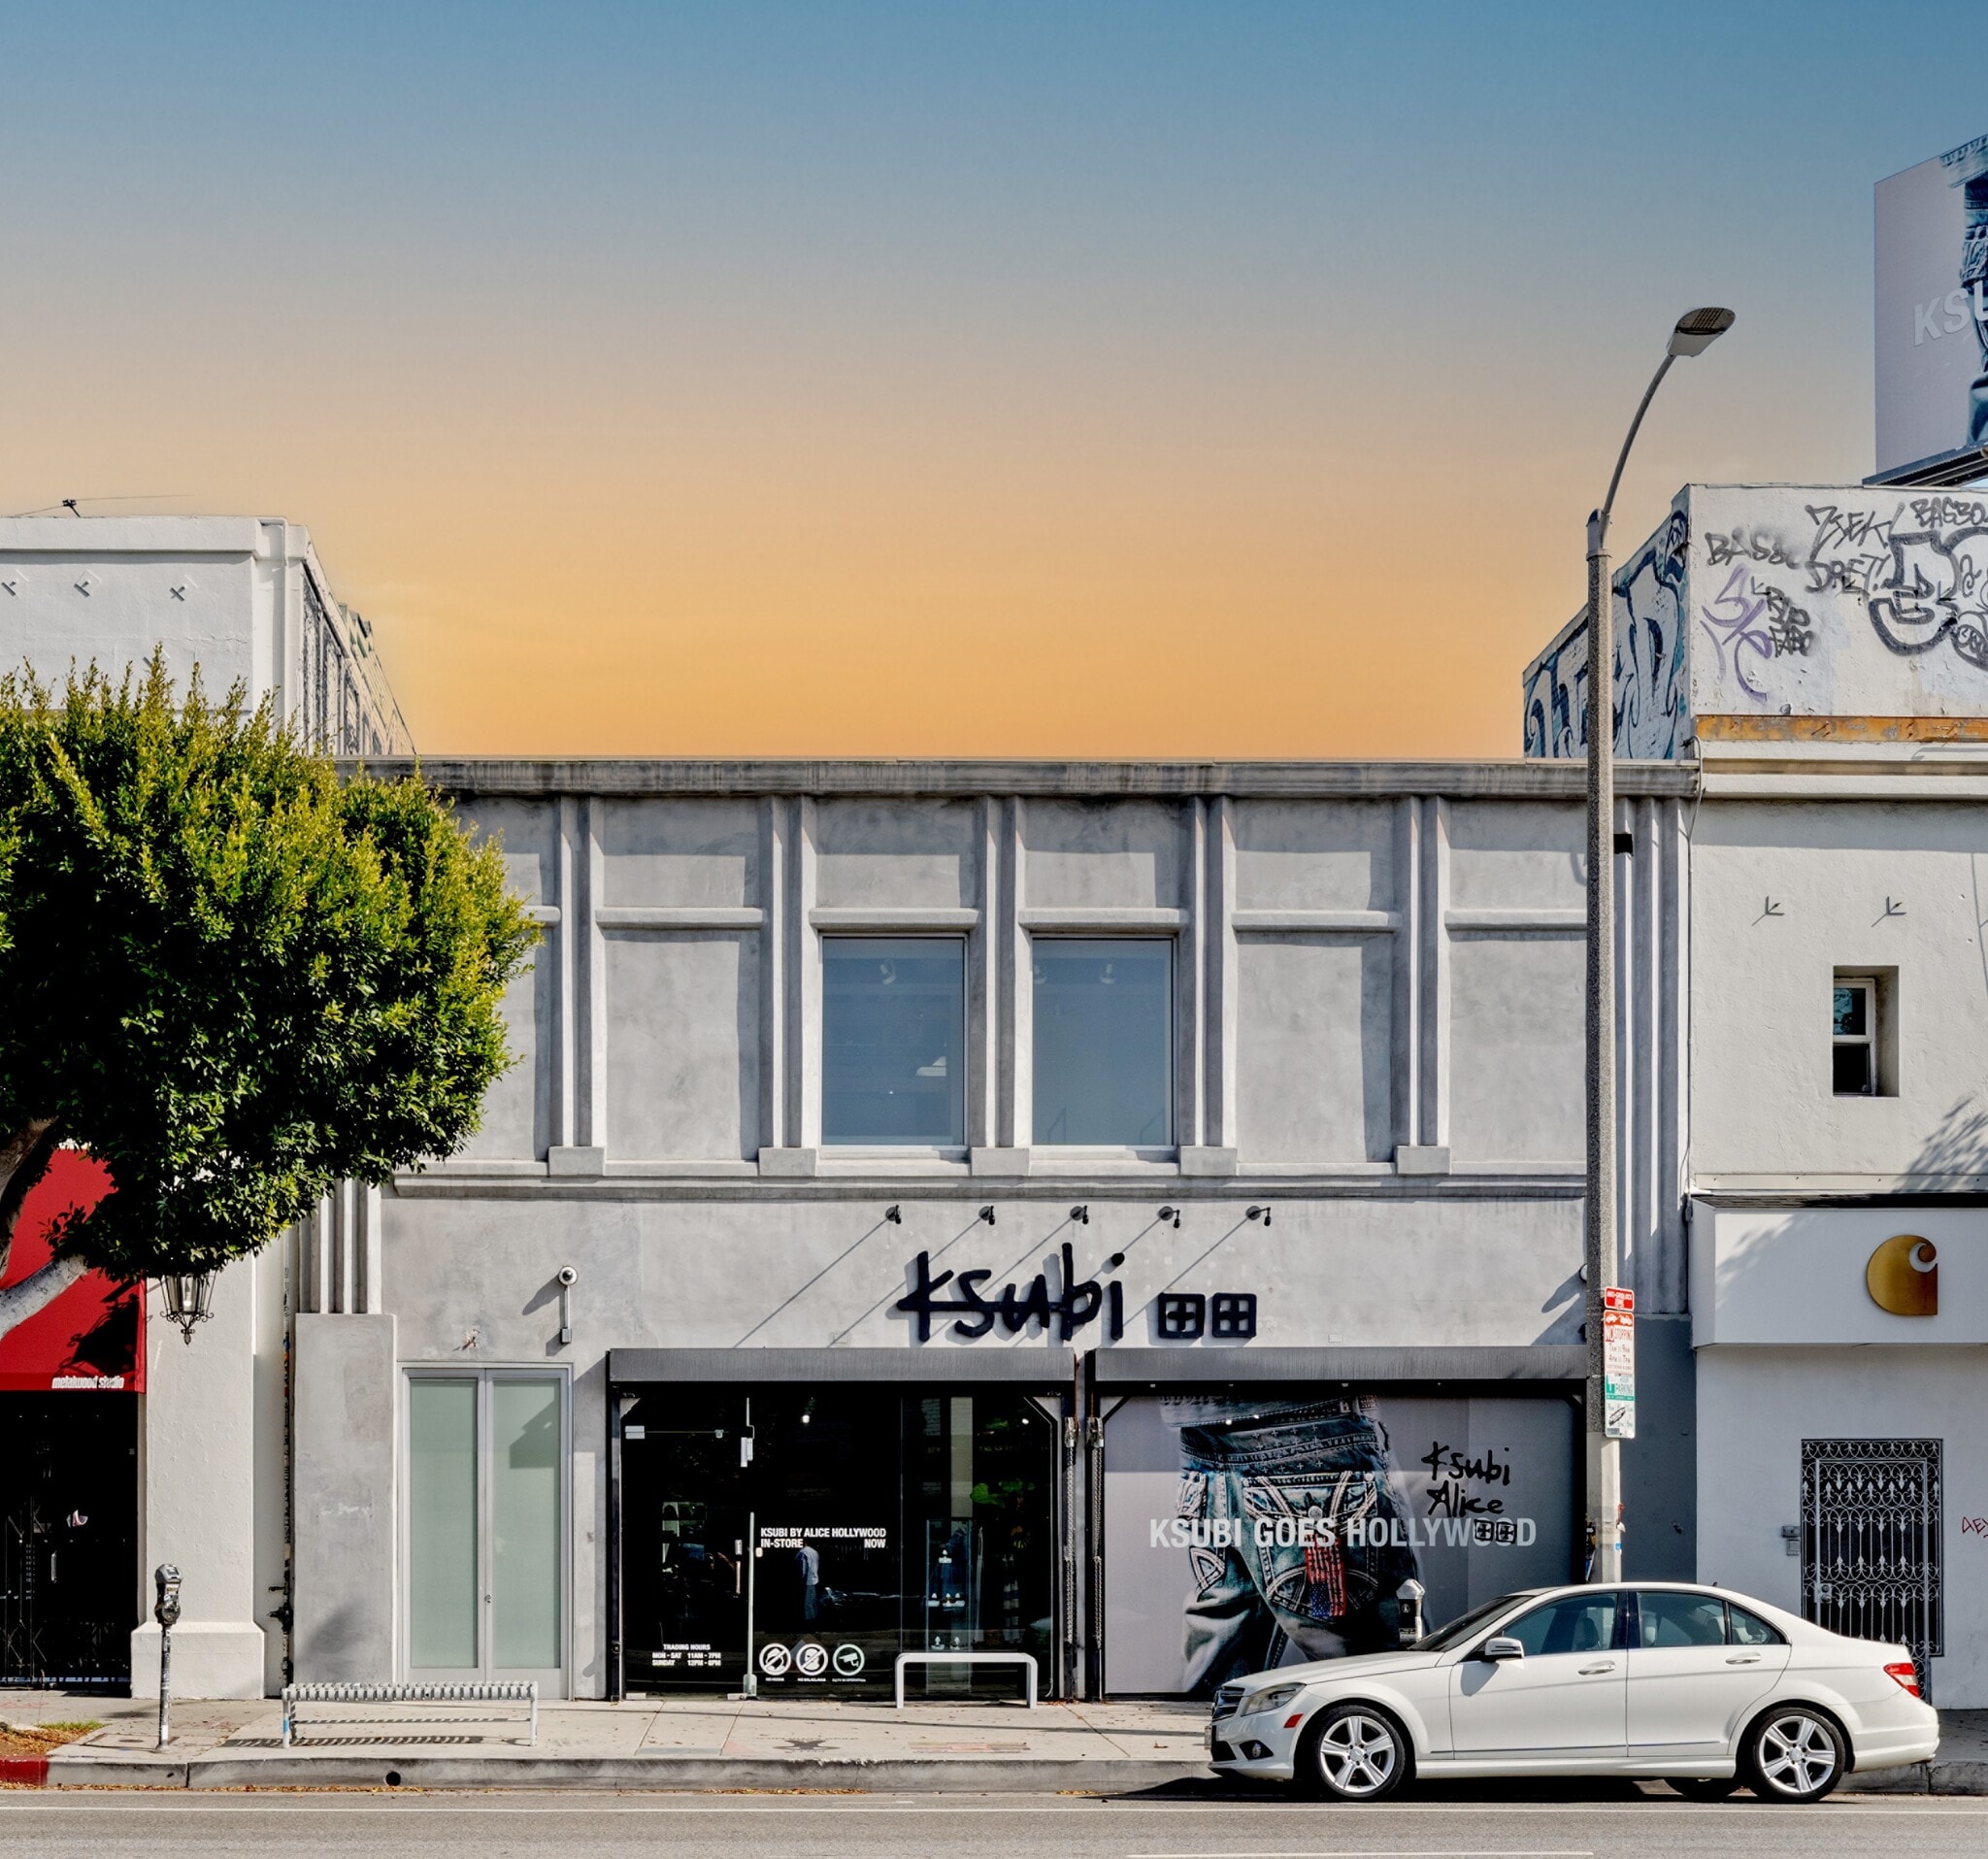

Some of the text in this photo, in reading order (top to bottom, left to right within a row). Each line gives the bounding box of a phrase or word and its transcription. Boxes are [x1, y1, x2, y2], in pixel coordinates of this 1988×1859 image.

[1426, 1479, 1505, 1517] Alice
[760, 1527, 886, 1538] KSUBI BY ALICE HOLLYWOOD
[760, 1538, 886, 1548] IN-STORE NOW
[1149, 1517, 1242, 1548] KSUBI
[1253, 1517, 1337, 1548] GOES
